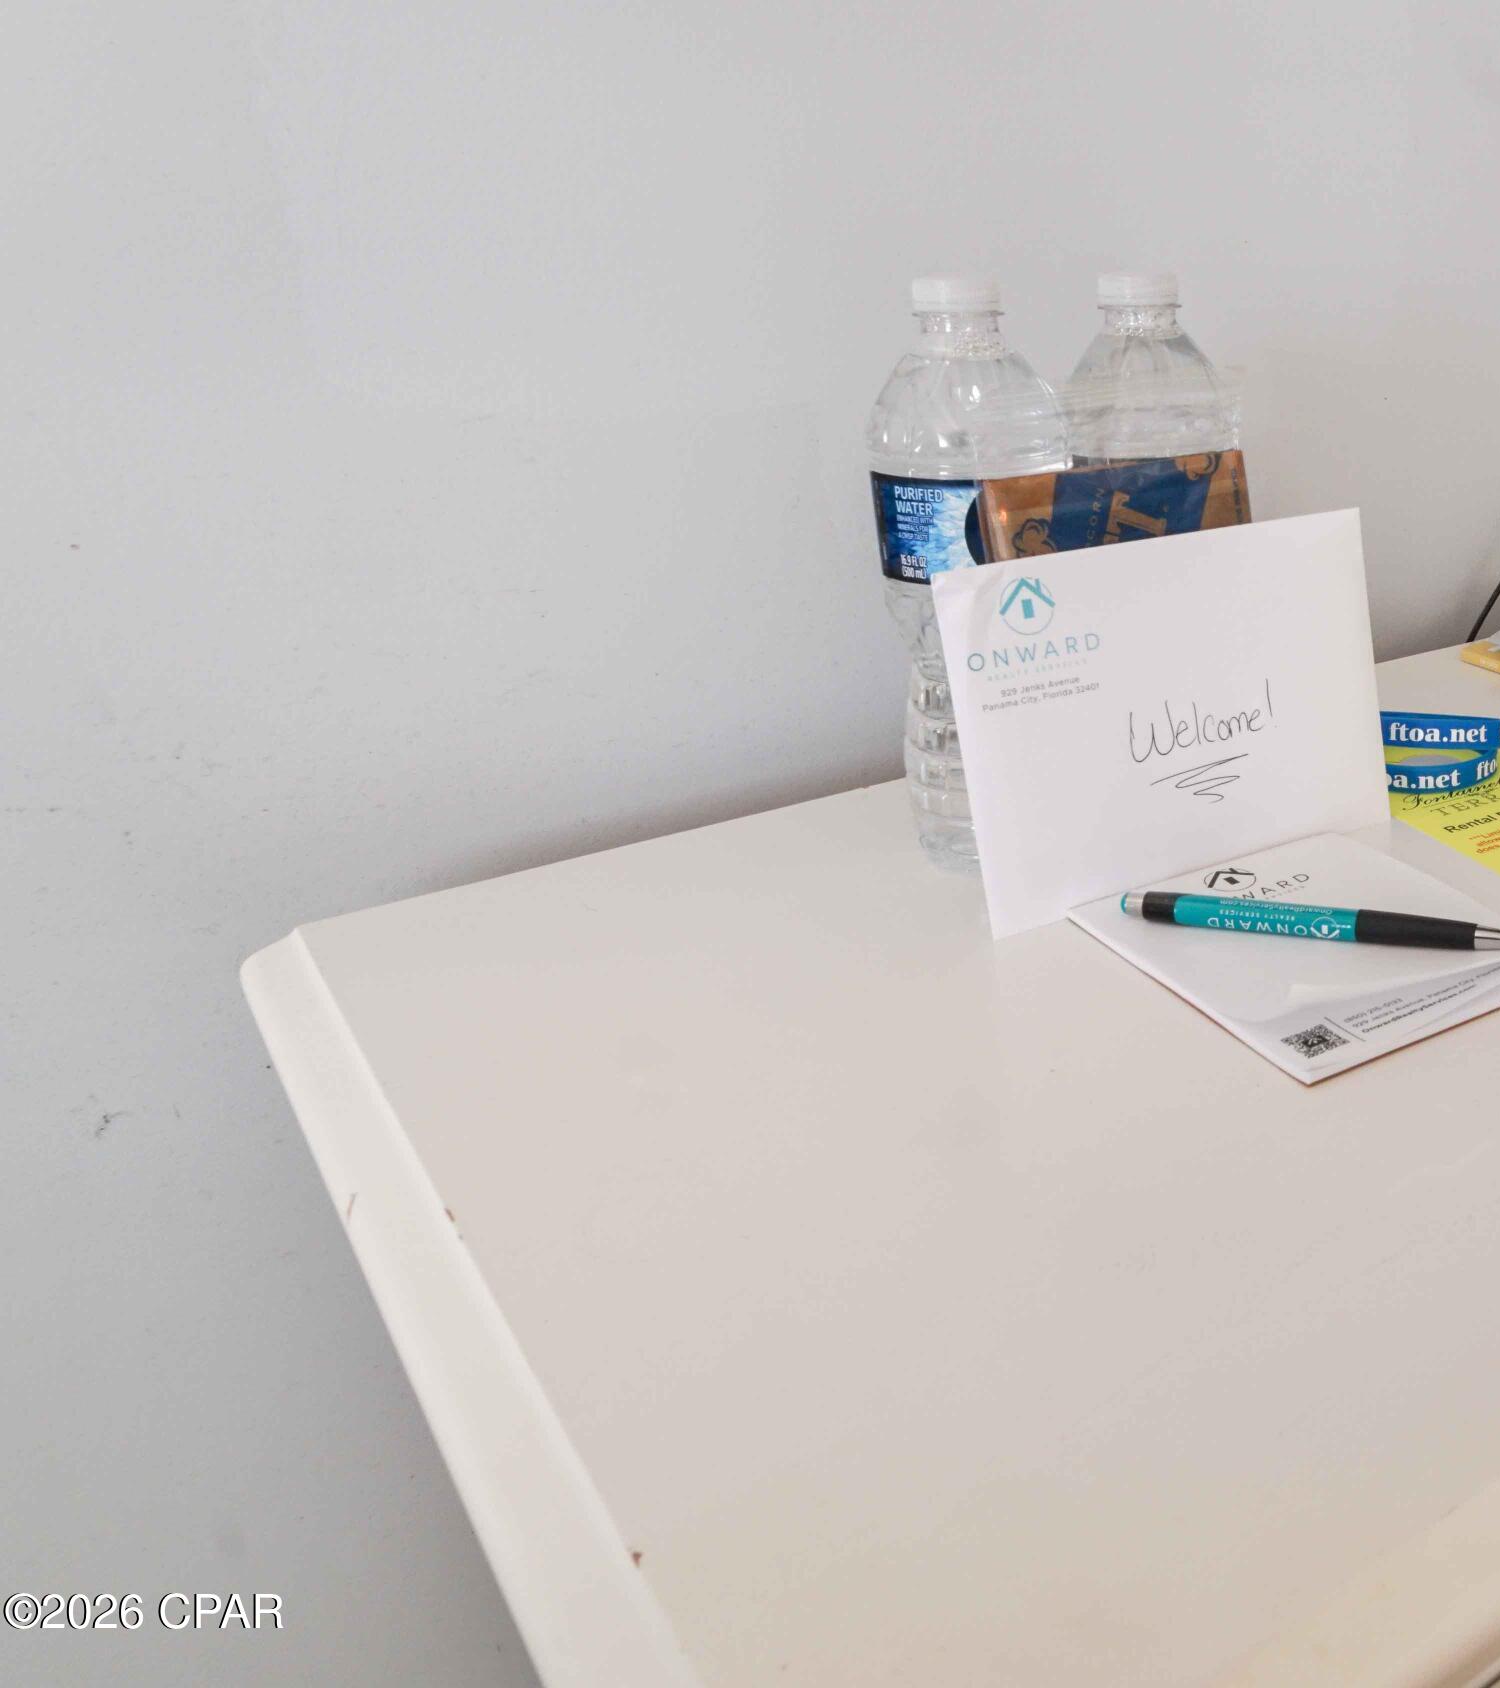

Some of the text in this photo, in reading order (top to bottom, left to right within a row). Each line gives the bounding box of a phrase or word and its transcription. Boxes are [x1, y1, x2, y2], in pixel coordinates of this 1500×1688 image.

[894, 485, 943, 502] PURIFIED
[895, 500, 933, 515] WATER
[900, 554, 928, 568] 16.9 FL OZ
[967, 633, 1100, 672] ONWARD
[1048, 677, 1080, 688] Avenue
[982, 699, 1018, 712] Panama
[1042, 689, 1073, 700] Florida
[1128, 678, 1278, 763] Welcome!
[1389, 722, 1487, 743] ftoa.net
[1443, 815, 1496, 833] Rental
[1220, 909, 1260, 919] SERVICES
[1207, 917, 1308, 936] ONWARD
